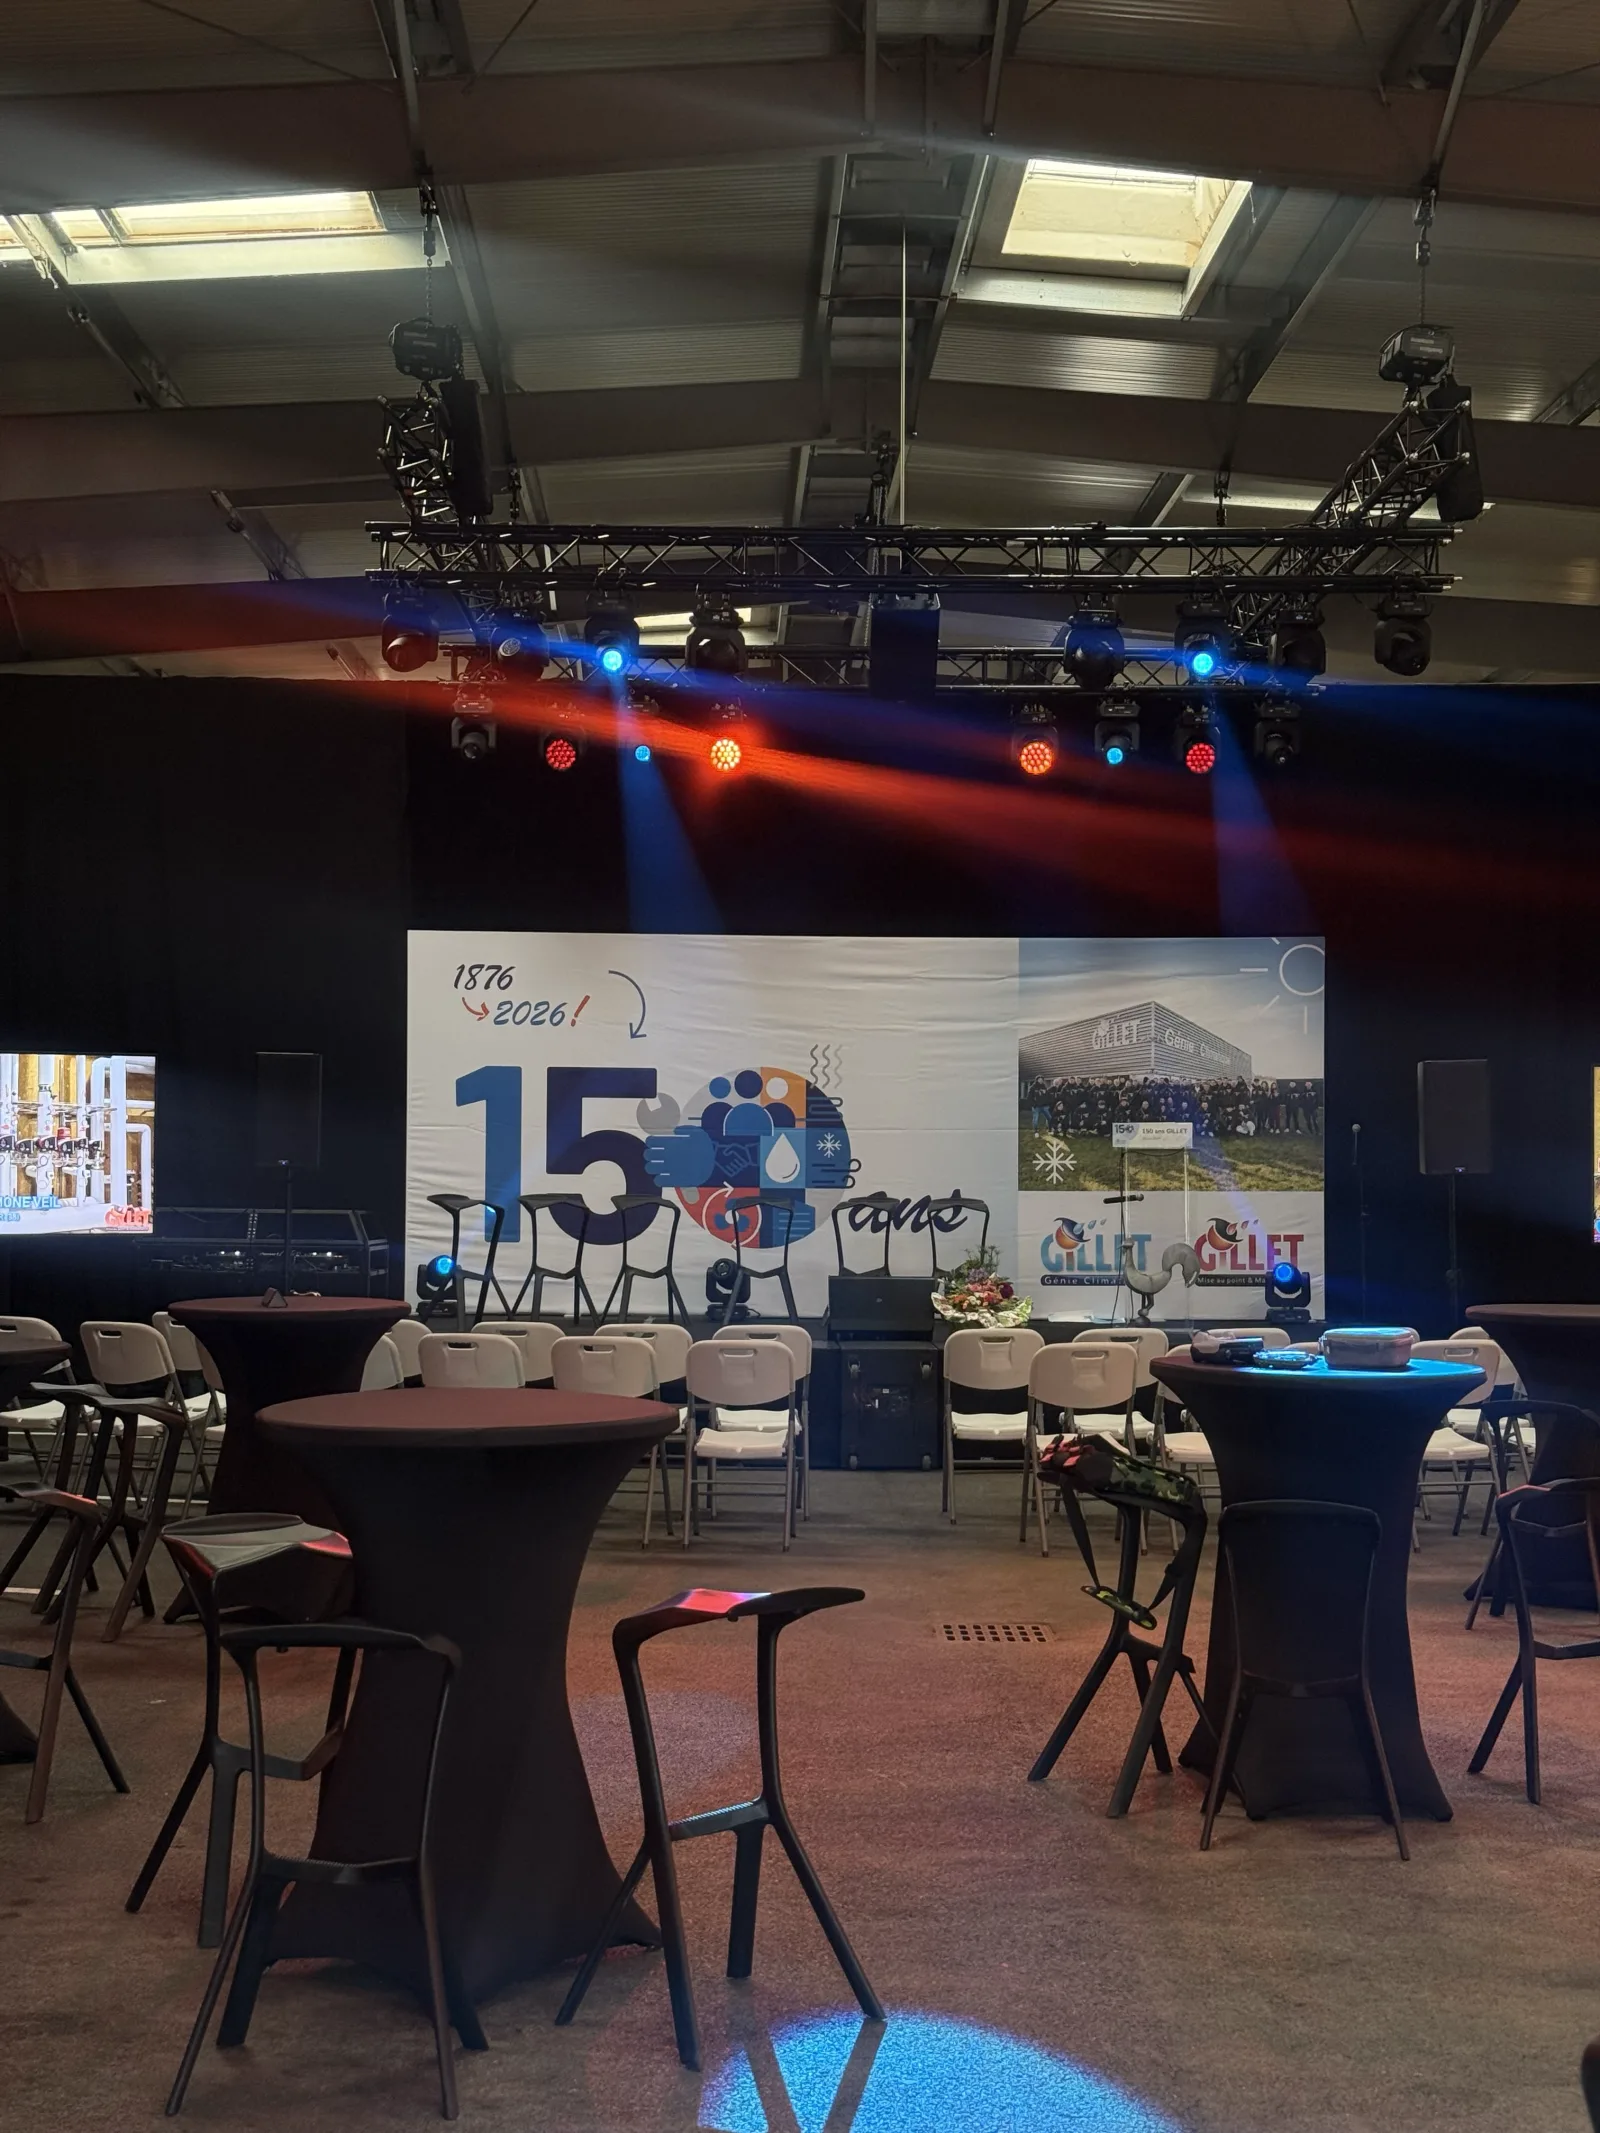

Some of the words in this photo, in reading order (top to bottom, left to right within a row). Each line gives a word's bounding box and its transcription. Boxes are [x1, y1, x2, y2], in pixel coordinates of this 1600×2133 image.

[453, 963, 516, 991] 1876
[493, 994, 591, 1028] 2026!
[848, 1188, 968, 1234] ans
